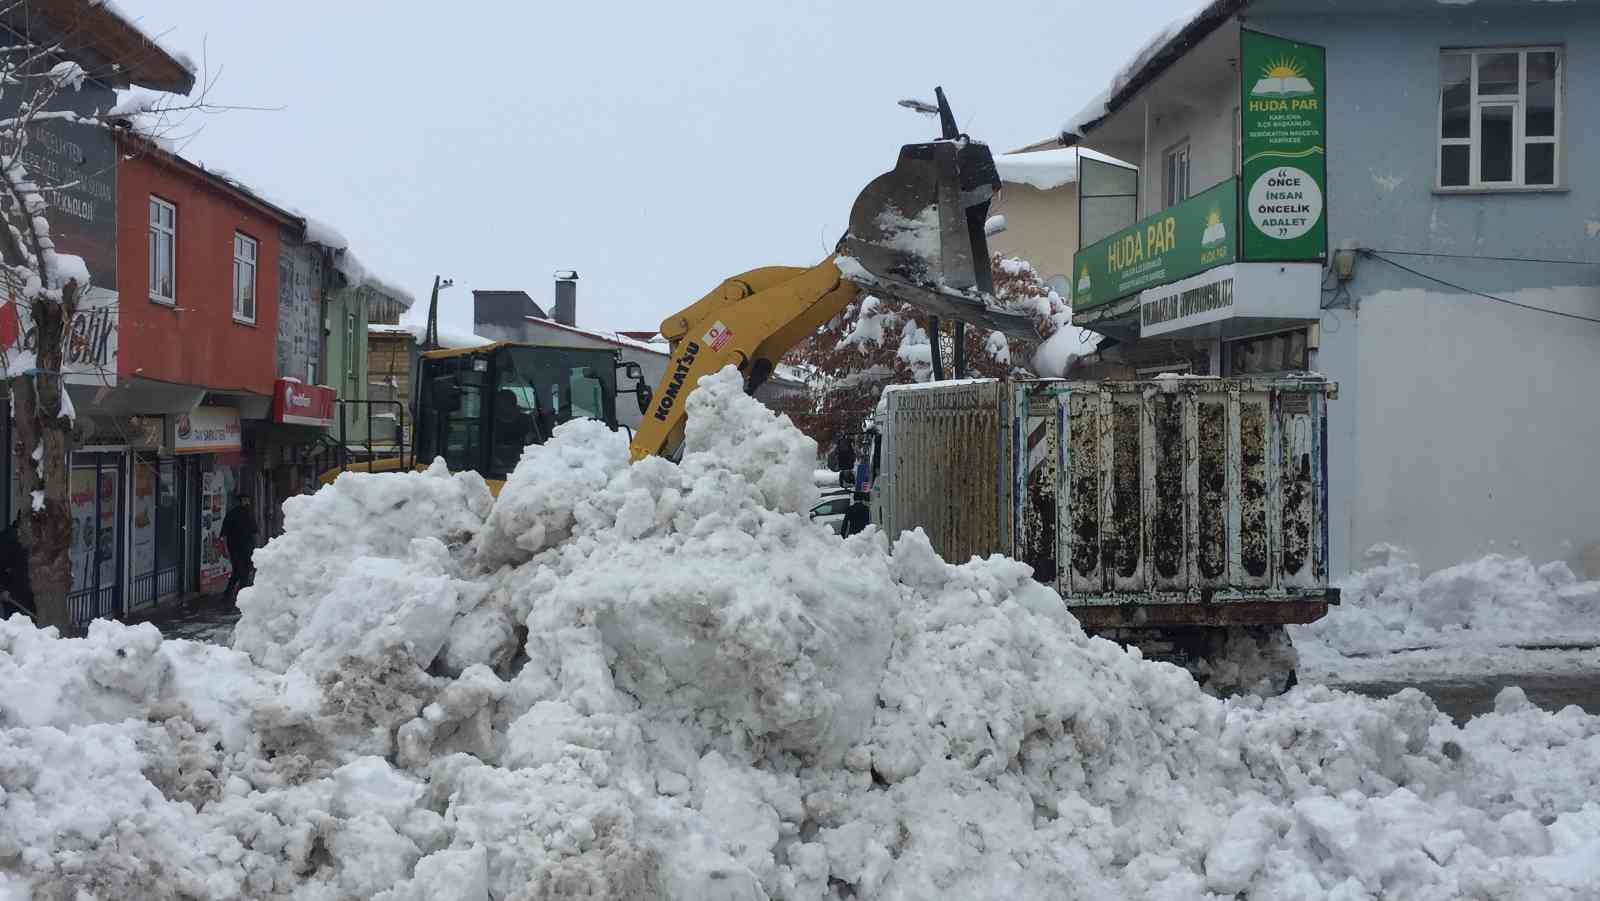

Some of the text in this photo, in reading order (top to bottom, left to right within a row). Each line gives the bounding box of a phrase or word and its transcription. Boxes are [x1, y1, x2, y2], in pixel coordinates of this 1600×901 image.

[1292, 99, 1318, 111] PAR
[1266, 190, 1303, 201] İNSAN
[1262, 218, 1307, 227] ADALET
[1147, 216, 1175, 259] PAR
[654, 341, 699, 422] KOMATSU
